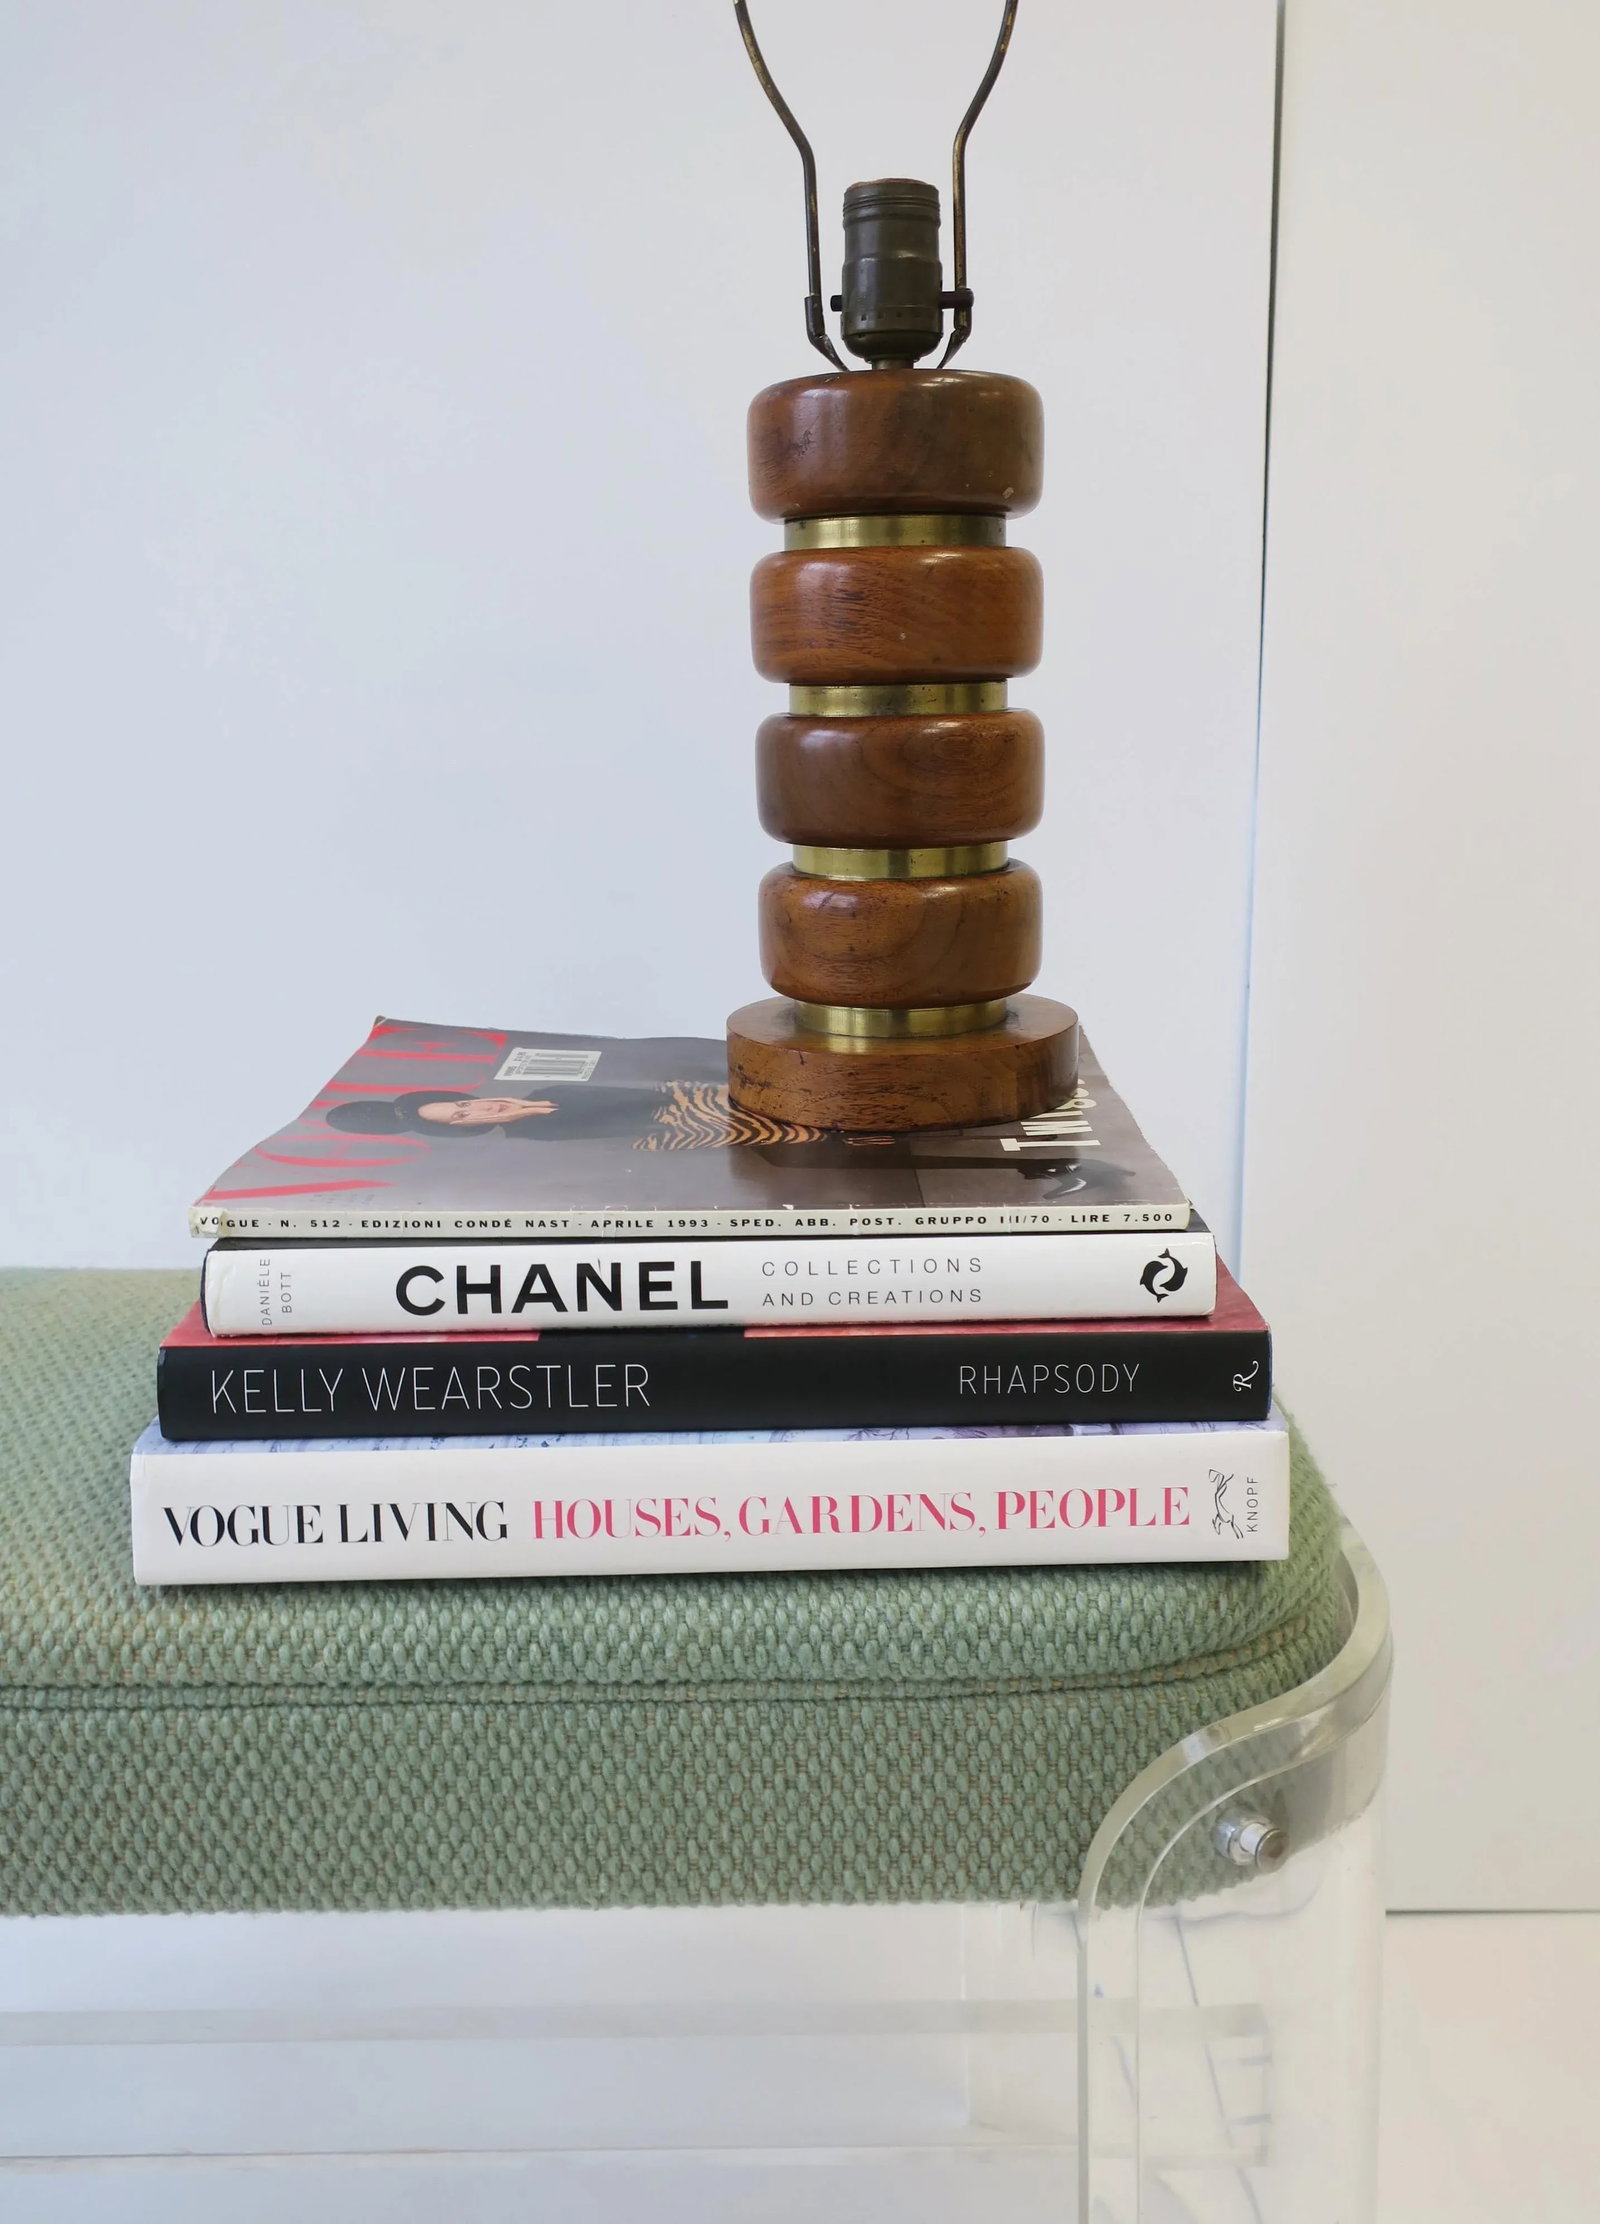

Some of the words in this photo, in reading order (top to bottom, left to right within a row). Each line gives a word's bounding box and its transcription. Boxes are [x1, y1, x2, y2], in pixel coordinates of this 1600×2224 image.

[191, 1022, 508, 1205] VOUE
[280, 1219, 297, 1228] N.
[310, 1219, 340, 1228] 512
[361, 1219, 442, 1229] EDIZIONI
[454, 1218, 512, 1229] CONDÉ
[525, 1219, 569, 1229] NAST
[590, 1219, 654, 1229] APRILE
[667, 1219, 709, 1228] 1993
[729, 1218, 782, 1228] SPED.
[794, 1218, 836, 1227] ABB.
[849, 1217, 902, 1227] POST.
[914, 1216, 987, 1226] GRUPPO
[1000, 1215, 1050, 1224] III/70
[1071, 1214, 1110, 1224] LIRE
[1123, 1213, 1173, 1223] 7.500
[257, 1258, 273, 1326] DANIÈLE
[280, 1271, 293, 1313] BOTT
[395, 1259, 729, 1317] CHANEL
[761, 1257, 983, 1277] COLLECTIONS
[762, 1292, 814, 1307] AND
[828, 1288, 983, 1306] CREATIONS
[211, 1368, 344, 1414] KELLY
[361, 1363, 651, 1412] WEARSTLER
[959, 1363, 1141, 1395] RHAPSODY
[162, 1503, 325, 1547] VOGUE
[338, 1500, 509, 1544] LIVING
[533, 1496, 731, 1542] HOUSES,
[738, 1491, 987, 1538] GARDENS,
[993, 1486, 1191, 1531] PEOPLE
[1246, 1476, 1259, 1533] KNOPF
